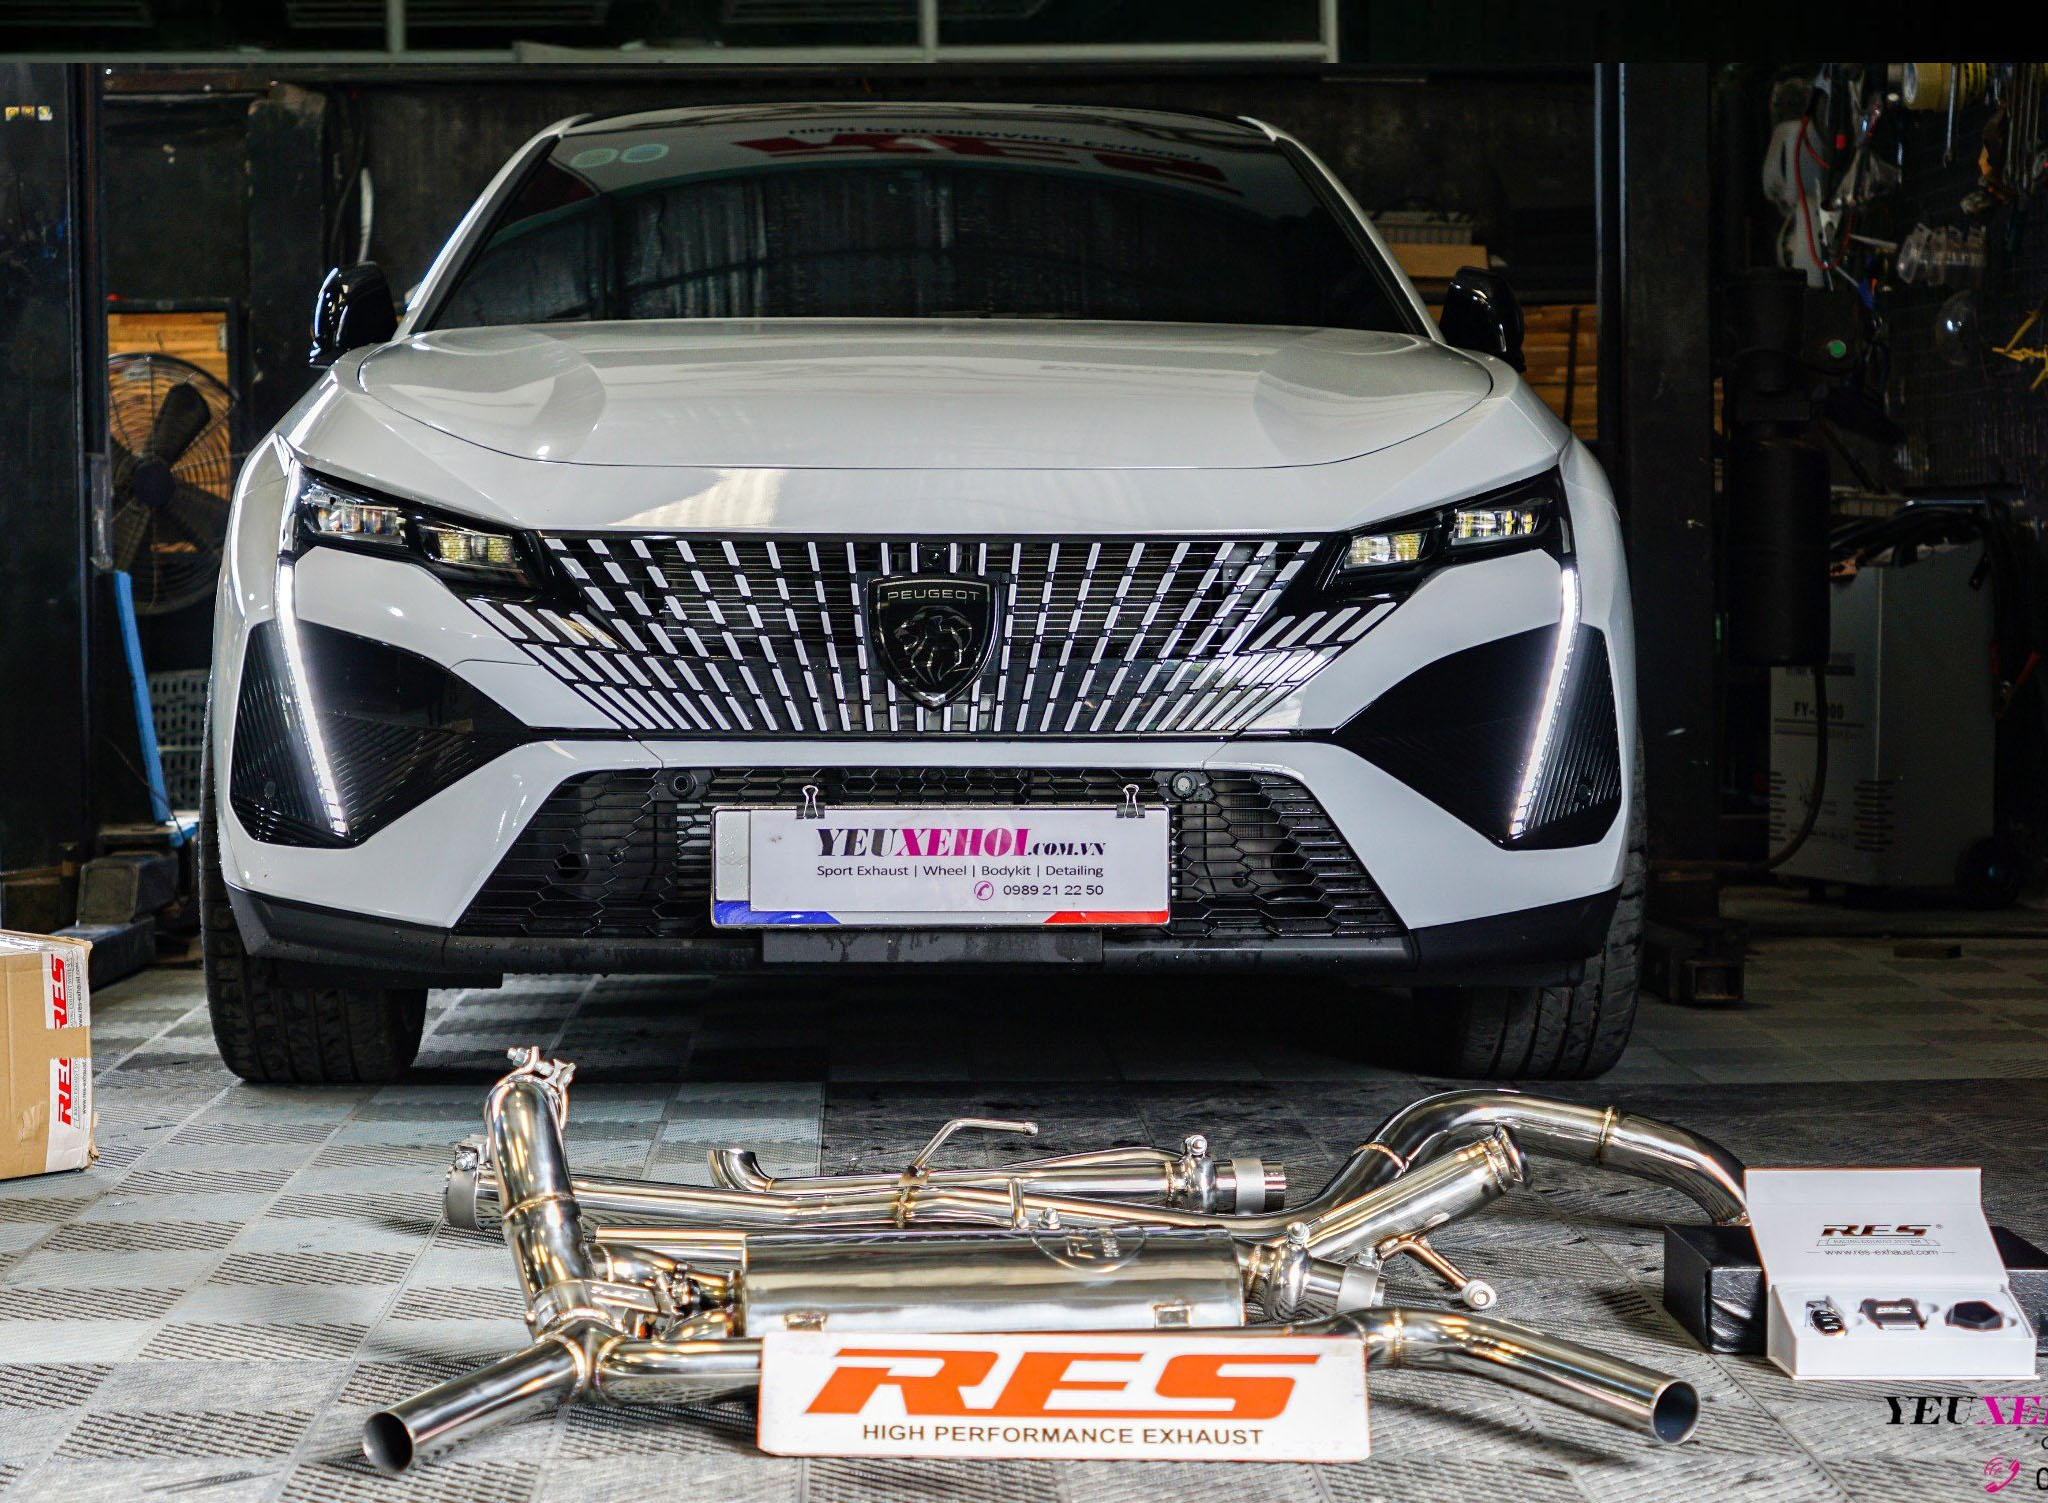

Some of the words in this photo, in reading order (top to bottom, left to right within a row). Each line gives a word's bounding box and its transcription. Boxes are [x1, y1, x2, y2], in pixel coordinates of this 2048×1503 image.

[887, 589, 980, 601] PEUGEOT
[816, 827, 1106, 857] YEUXEHOI.COM.VN
[817, 865, 853, 879] Sport
[857, 864, 909, 877] Exhaust
[923, 864, 967, 877] Wheel
[981, 864, 1031, 879] Bodykit
[1046, 864, 1104, 879] Detailing
[1003, 885, 1039, 896] 0989
[1042, 885, 1059, 896] 21
[1064, 885, 1083, 896] 22
[1086, 885, 1104, 896] 50
[51, 953, 67, 1029] RES
[1821, 1224, 1932, 1237] RES
[1824, 1248, 1939, 1256] www.res-exhaust.com
[805, 1348, 1320, 1420] RES
[863, 1424, 925, 1441] HIGH
[934, 1426, 1133, 1444] PERFORMANCE
[1144, 1428, 1264, 1445] EXHAUST
